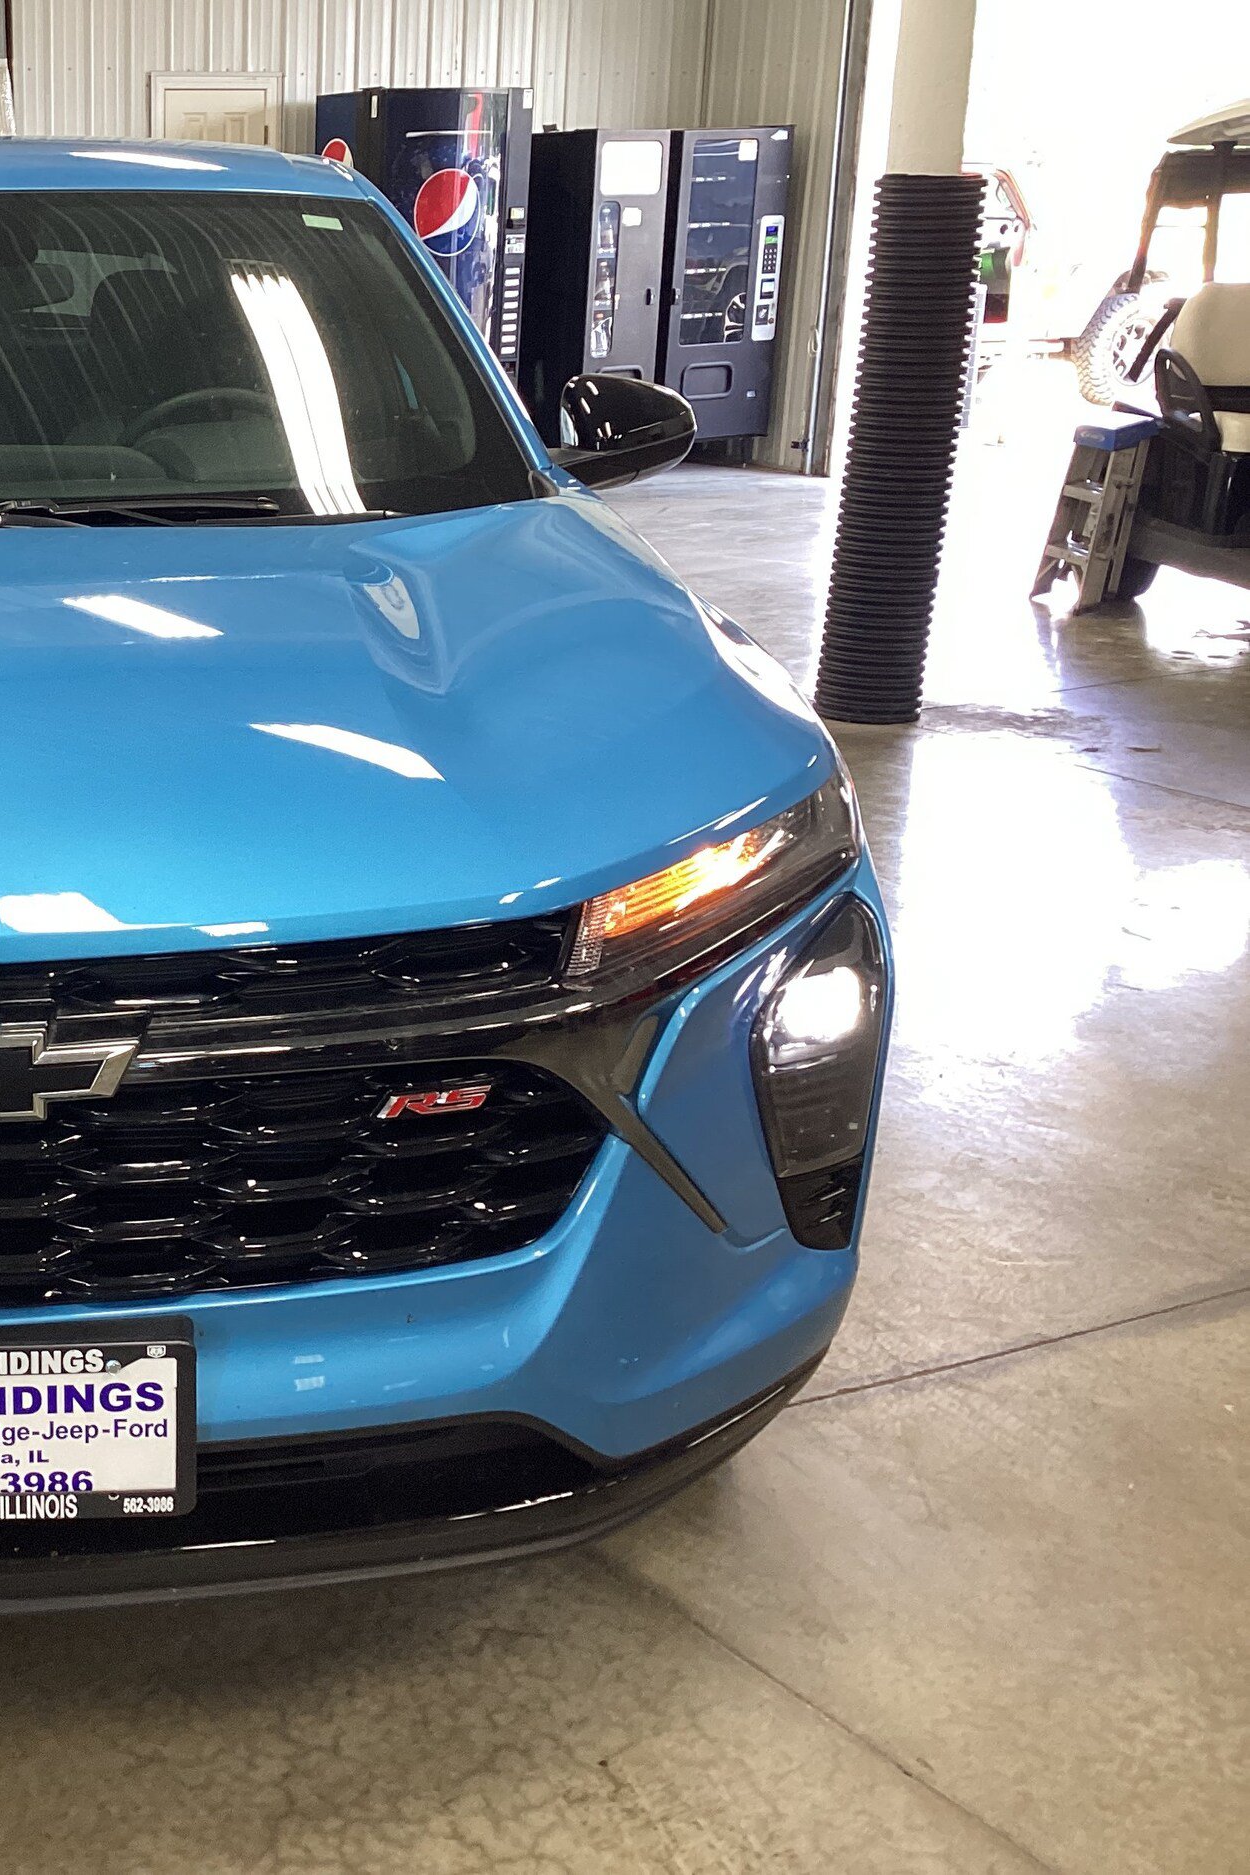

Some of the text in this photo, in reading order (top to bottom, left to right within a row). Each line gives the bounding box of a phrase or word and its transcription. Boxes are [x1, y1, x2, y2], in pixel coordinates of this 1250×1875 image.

[377, 1085, 492, 1119] RS
[29, 1450, 50, 1464] IL
[0, 1494, 78, 1519] ILLINOIS
[123, 1496, 174, 1513] 562-3986
